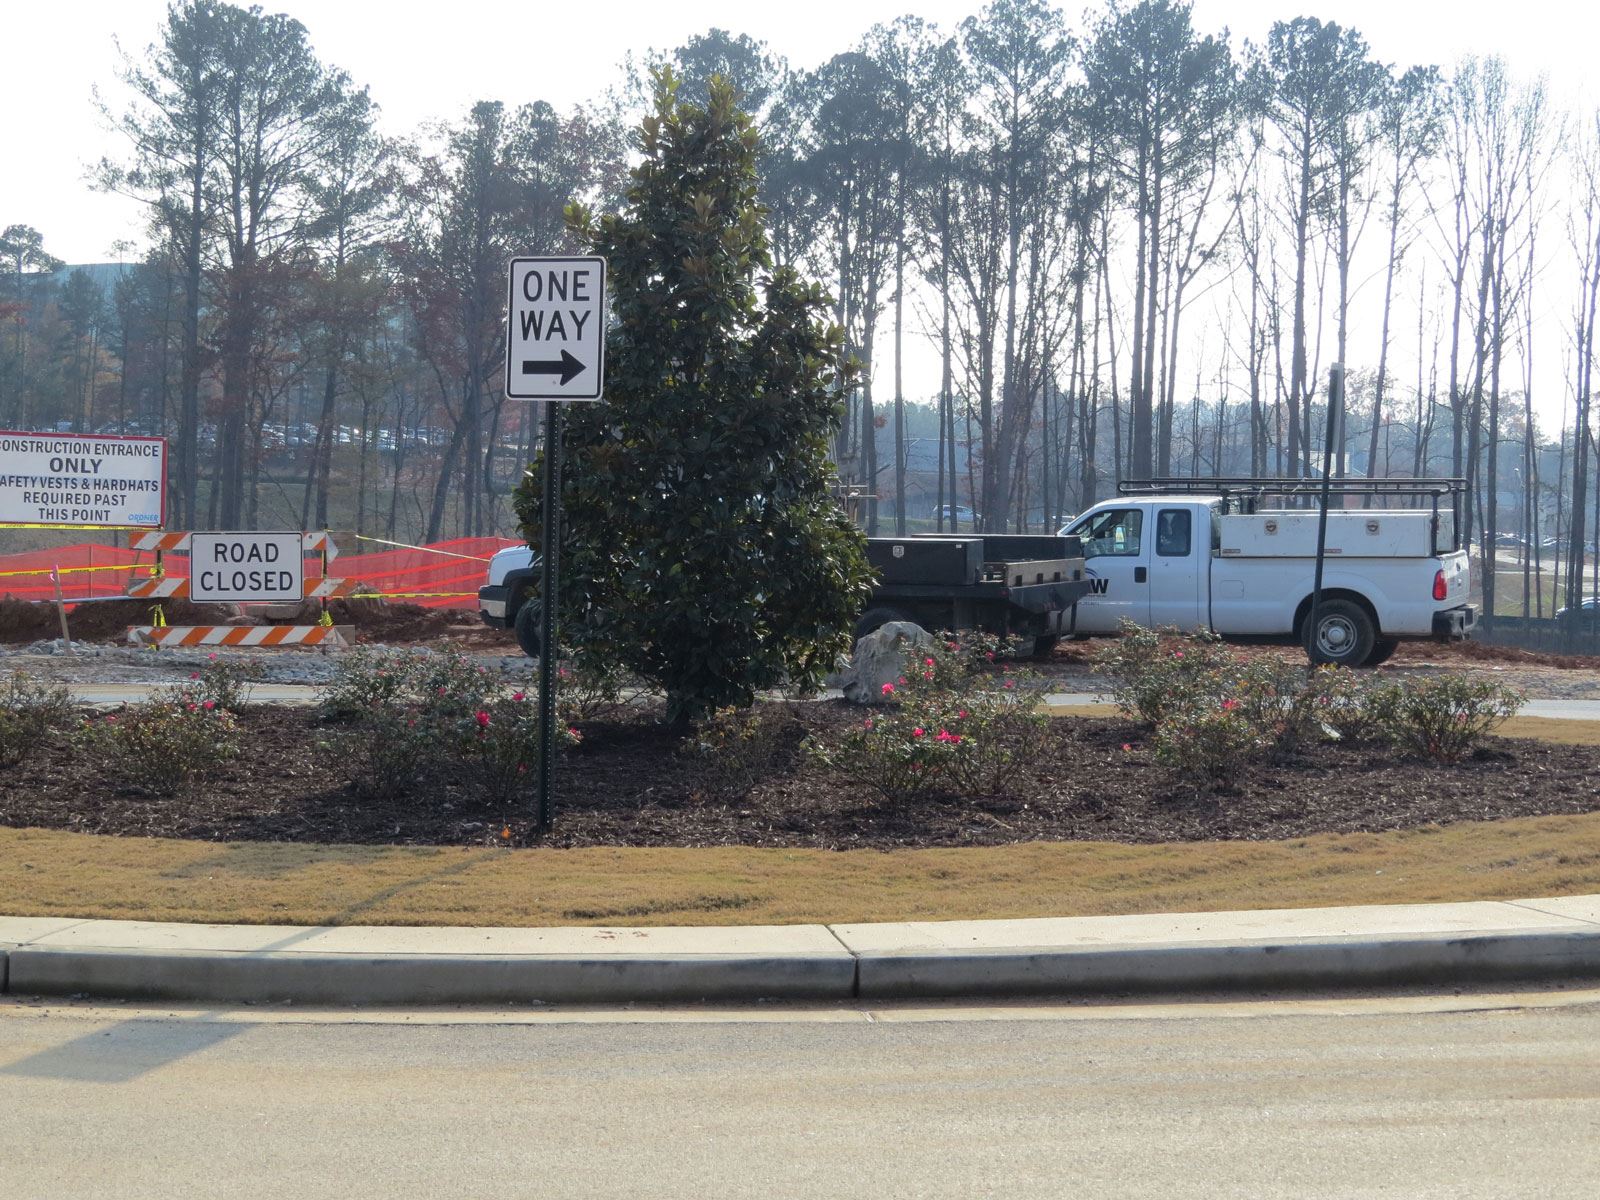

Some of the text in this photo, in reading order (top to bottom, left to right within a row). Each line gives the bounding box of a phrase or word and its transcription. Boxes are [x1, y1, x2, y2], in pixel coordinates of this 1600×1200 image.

[523, 270, 590, 302] ONE
[520, 310, 591, 341] WAY
[0, 439, 159, 457] ONSTRUCTION ENTRANCE
[49, 457, 103, 474] ONLY
[0, 475, 159, 492] AFETY VESTS & HARDHATS
[23, 491, 127, 506] REQUIRED PAST
[38, 508, 111, 521] THIS POINT
[214, 543, 279, 563] ROAD
[200, 571, 293, 592] CLOSED
